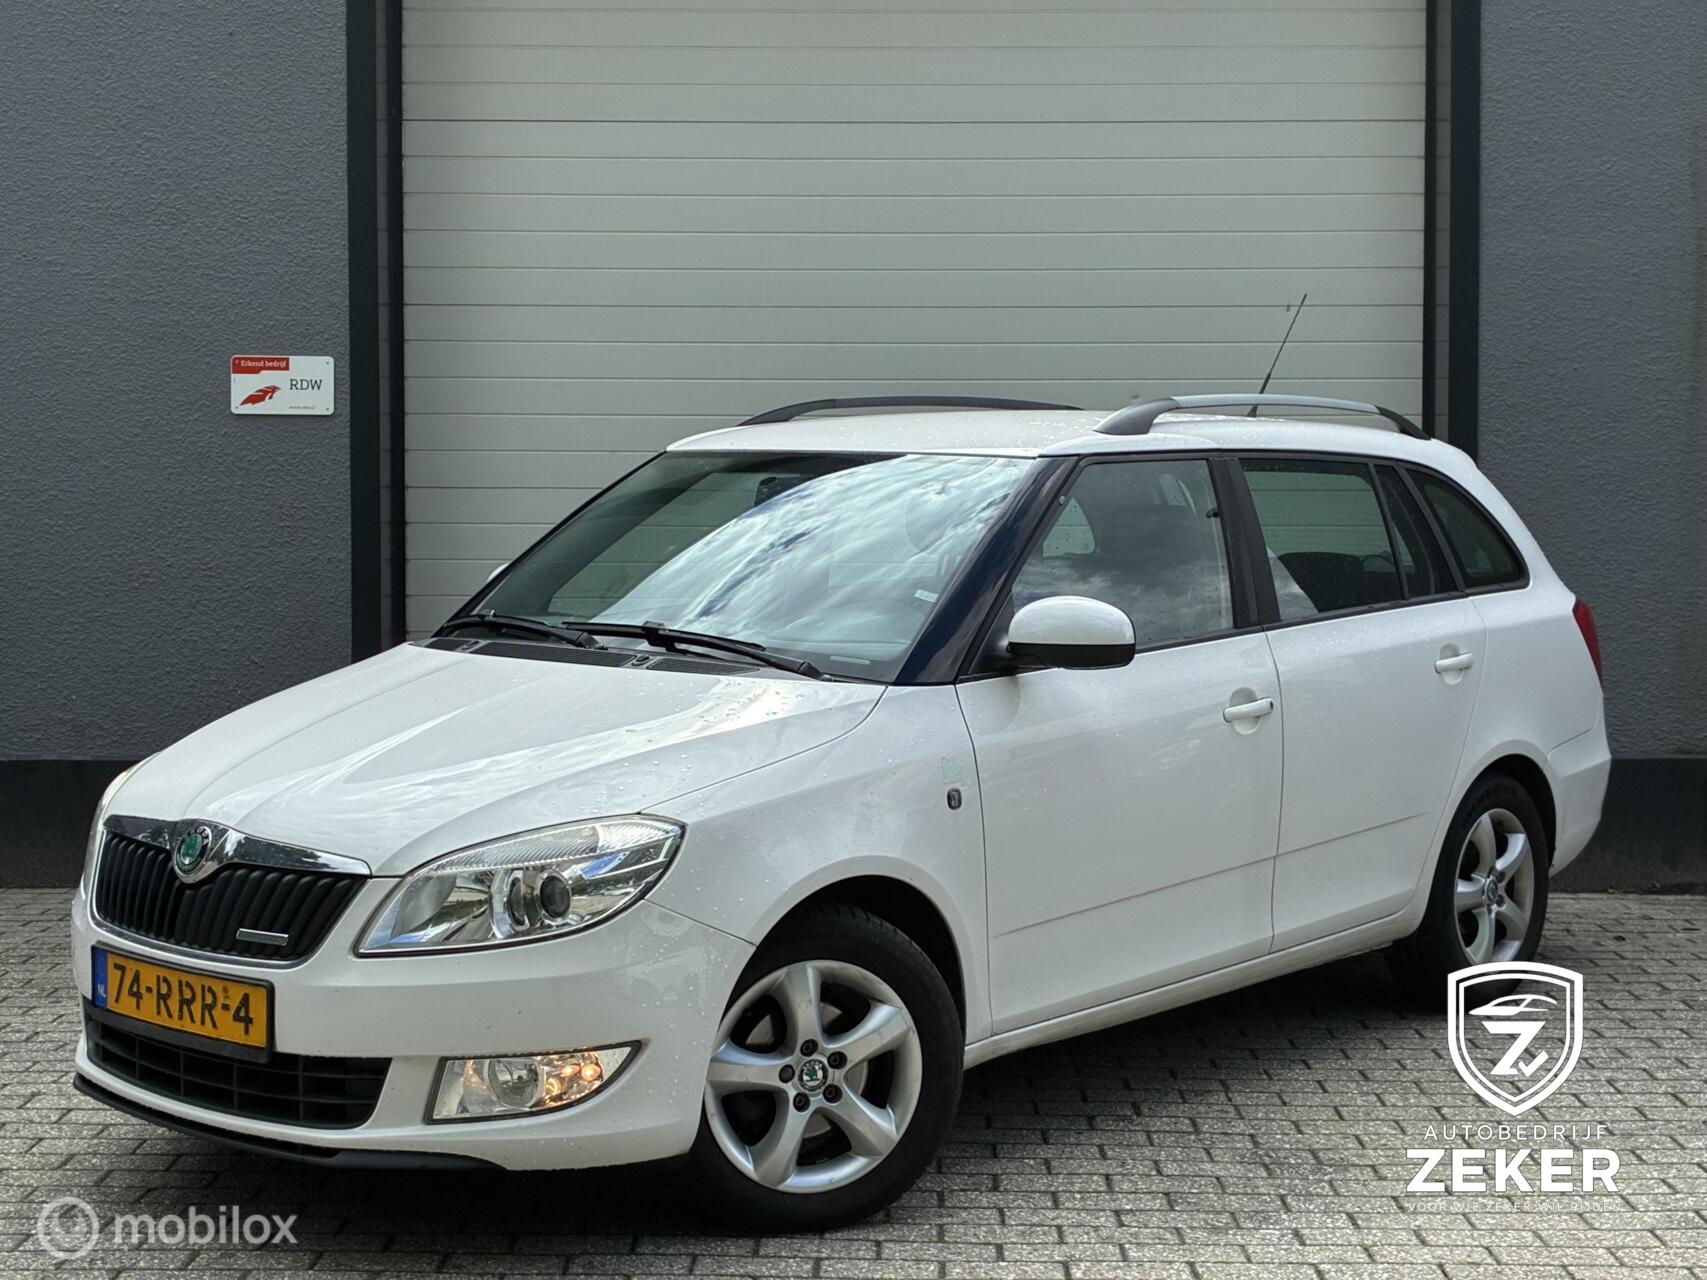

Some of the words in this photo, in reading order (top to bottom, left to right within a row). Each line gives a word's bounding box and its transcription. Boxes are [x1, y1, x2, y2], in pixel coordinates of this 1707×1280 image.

[265, 360, 287, 368] bedrijf
[289, 378, 323, 391] RDW
[113, 962, 253, 1036] 74-RRR-4
